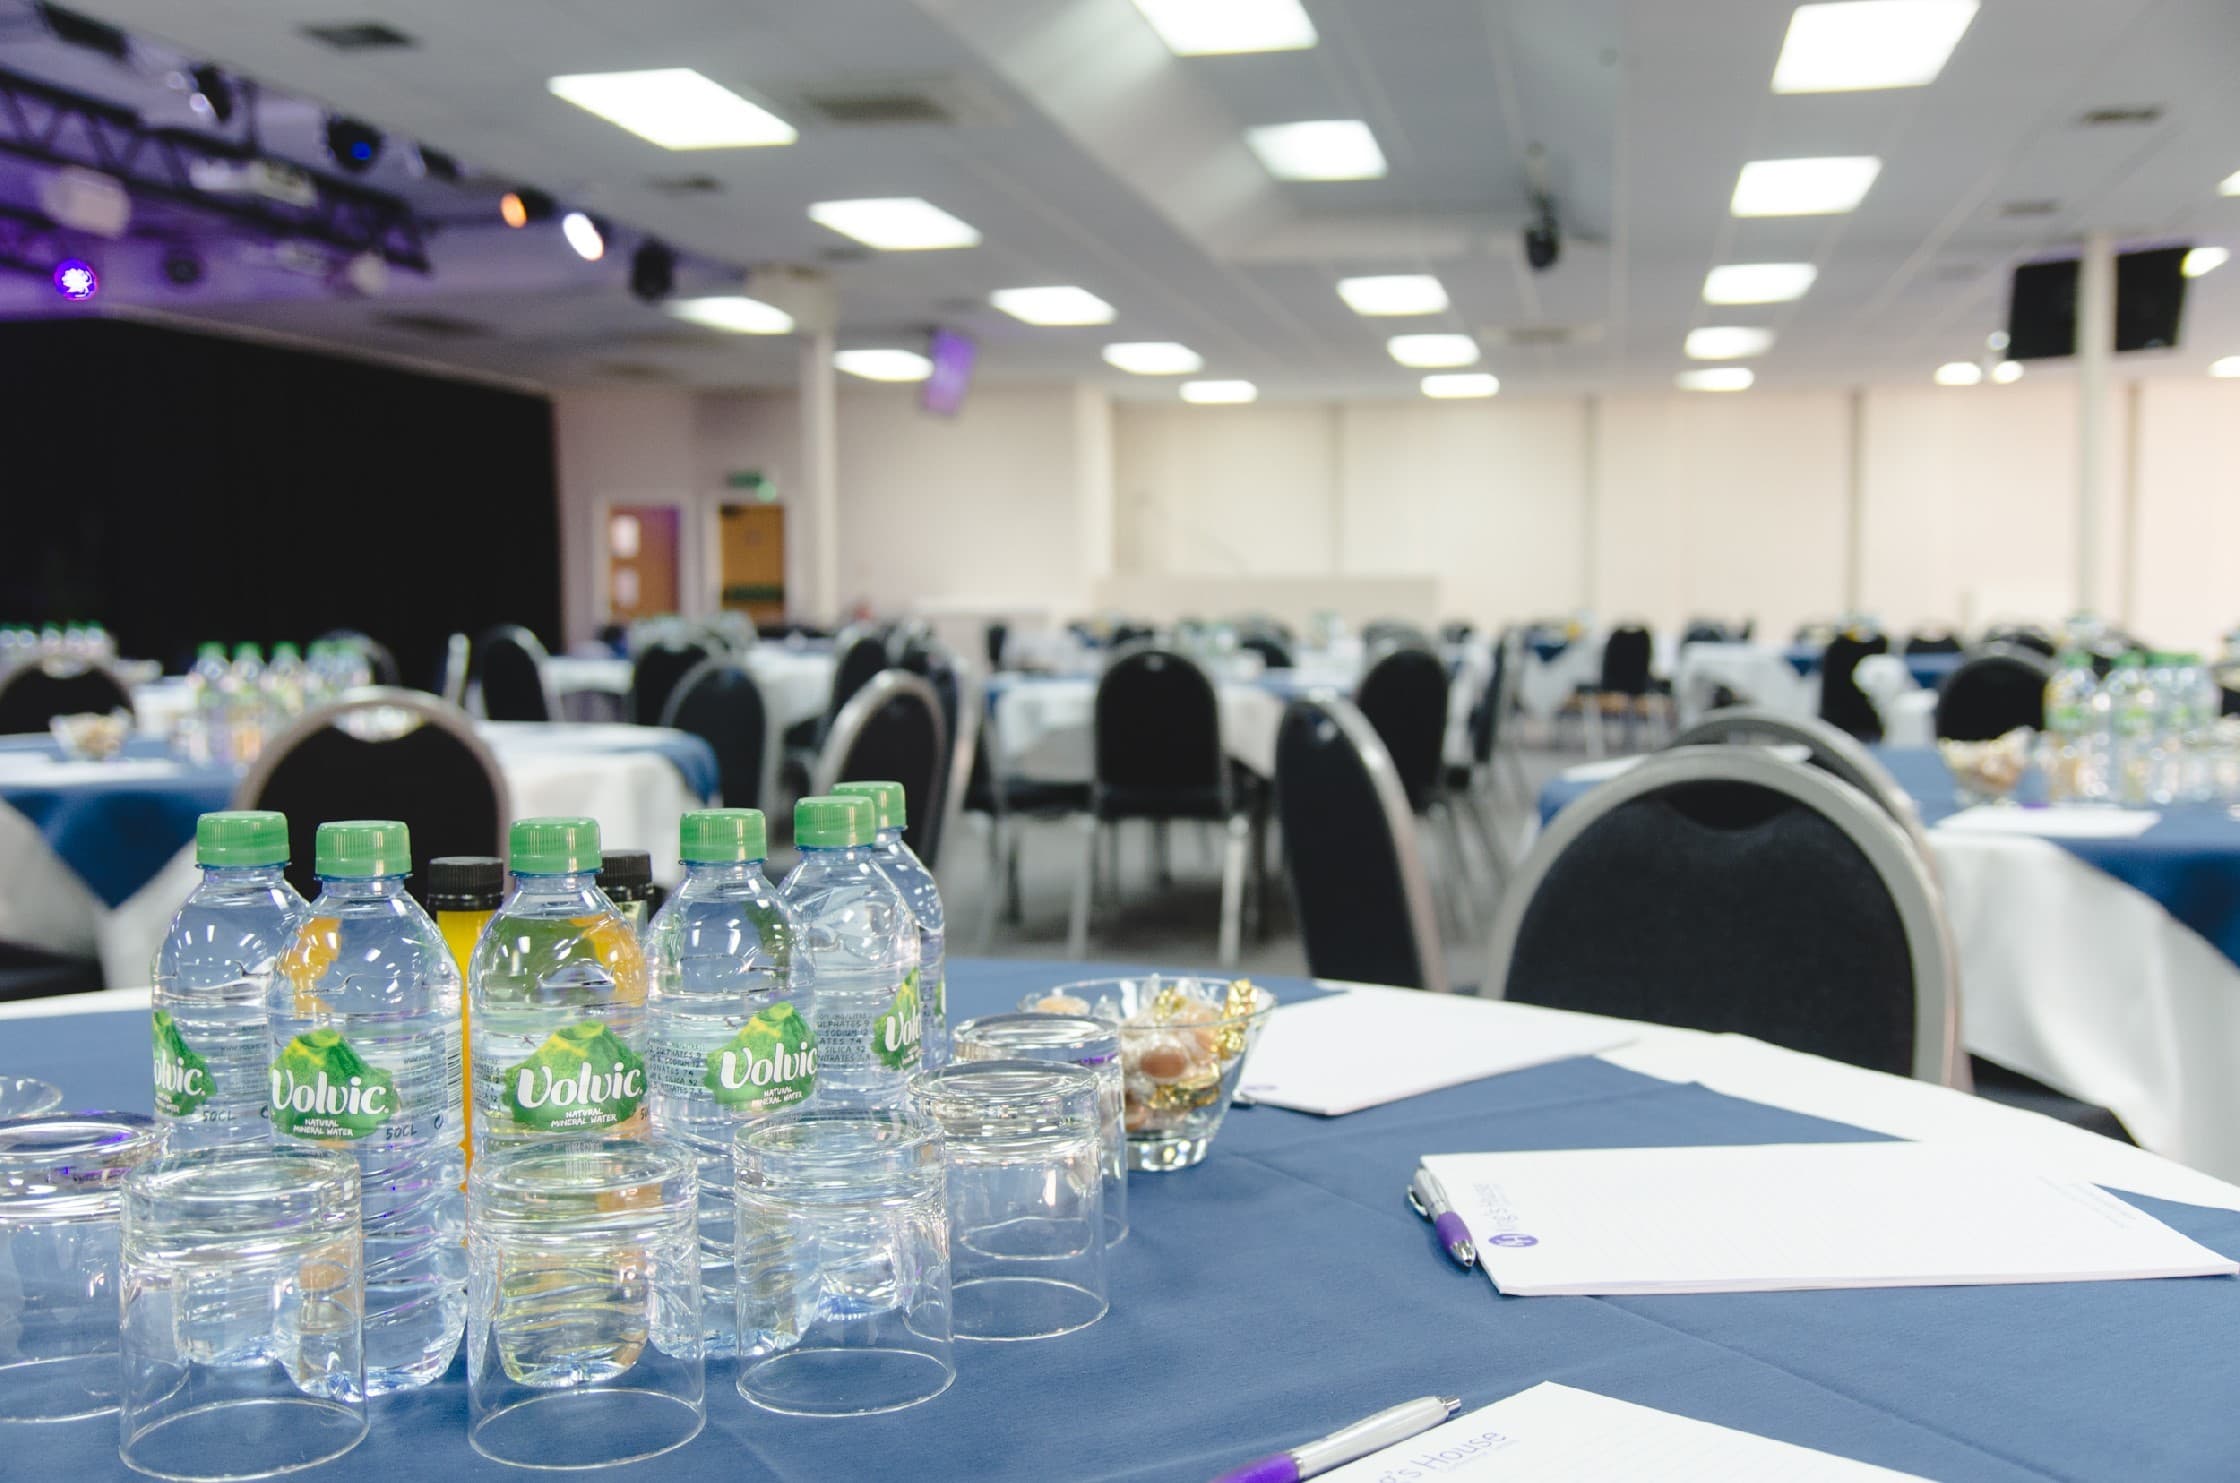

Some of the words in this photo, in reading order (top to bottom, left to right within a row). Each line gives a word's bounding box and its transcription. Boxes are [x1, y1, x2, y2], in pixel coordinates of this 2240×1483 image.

[154, 1048, 203, 1096] olvic
[720, 1042, 818, 1089] Volvic
[272, 1068, 387, 1114] Volvic
[517, 1062, 641, 1108] Volvic
[304, 1118, 340, 1128] NATURAL
[551, 1118, 586, 1128] MINERAL
[590, 1113, 618, 1123] WATER
[566, 1107, 604, 1118] NATURAL
[293, 1125, 325, 1136] MINERAL
[326, 1127, 353, 1137] WATER
[385, 1123, 418, 1140] 50CL
[1410, 1431, 1506, 1470] House
